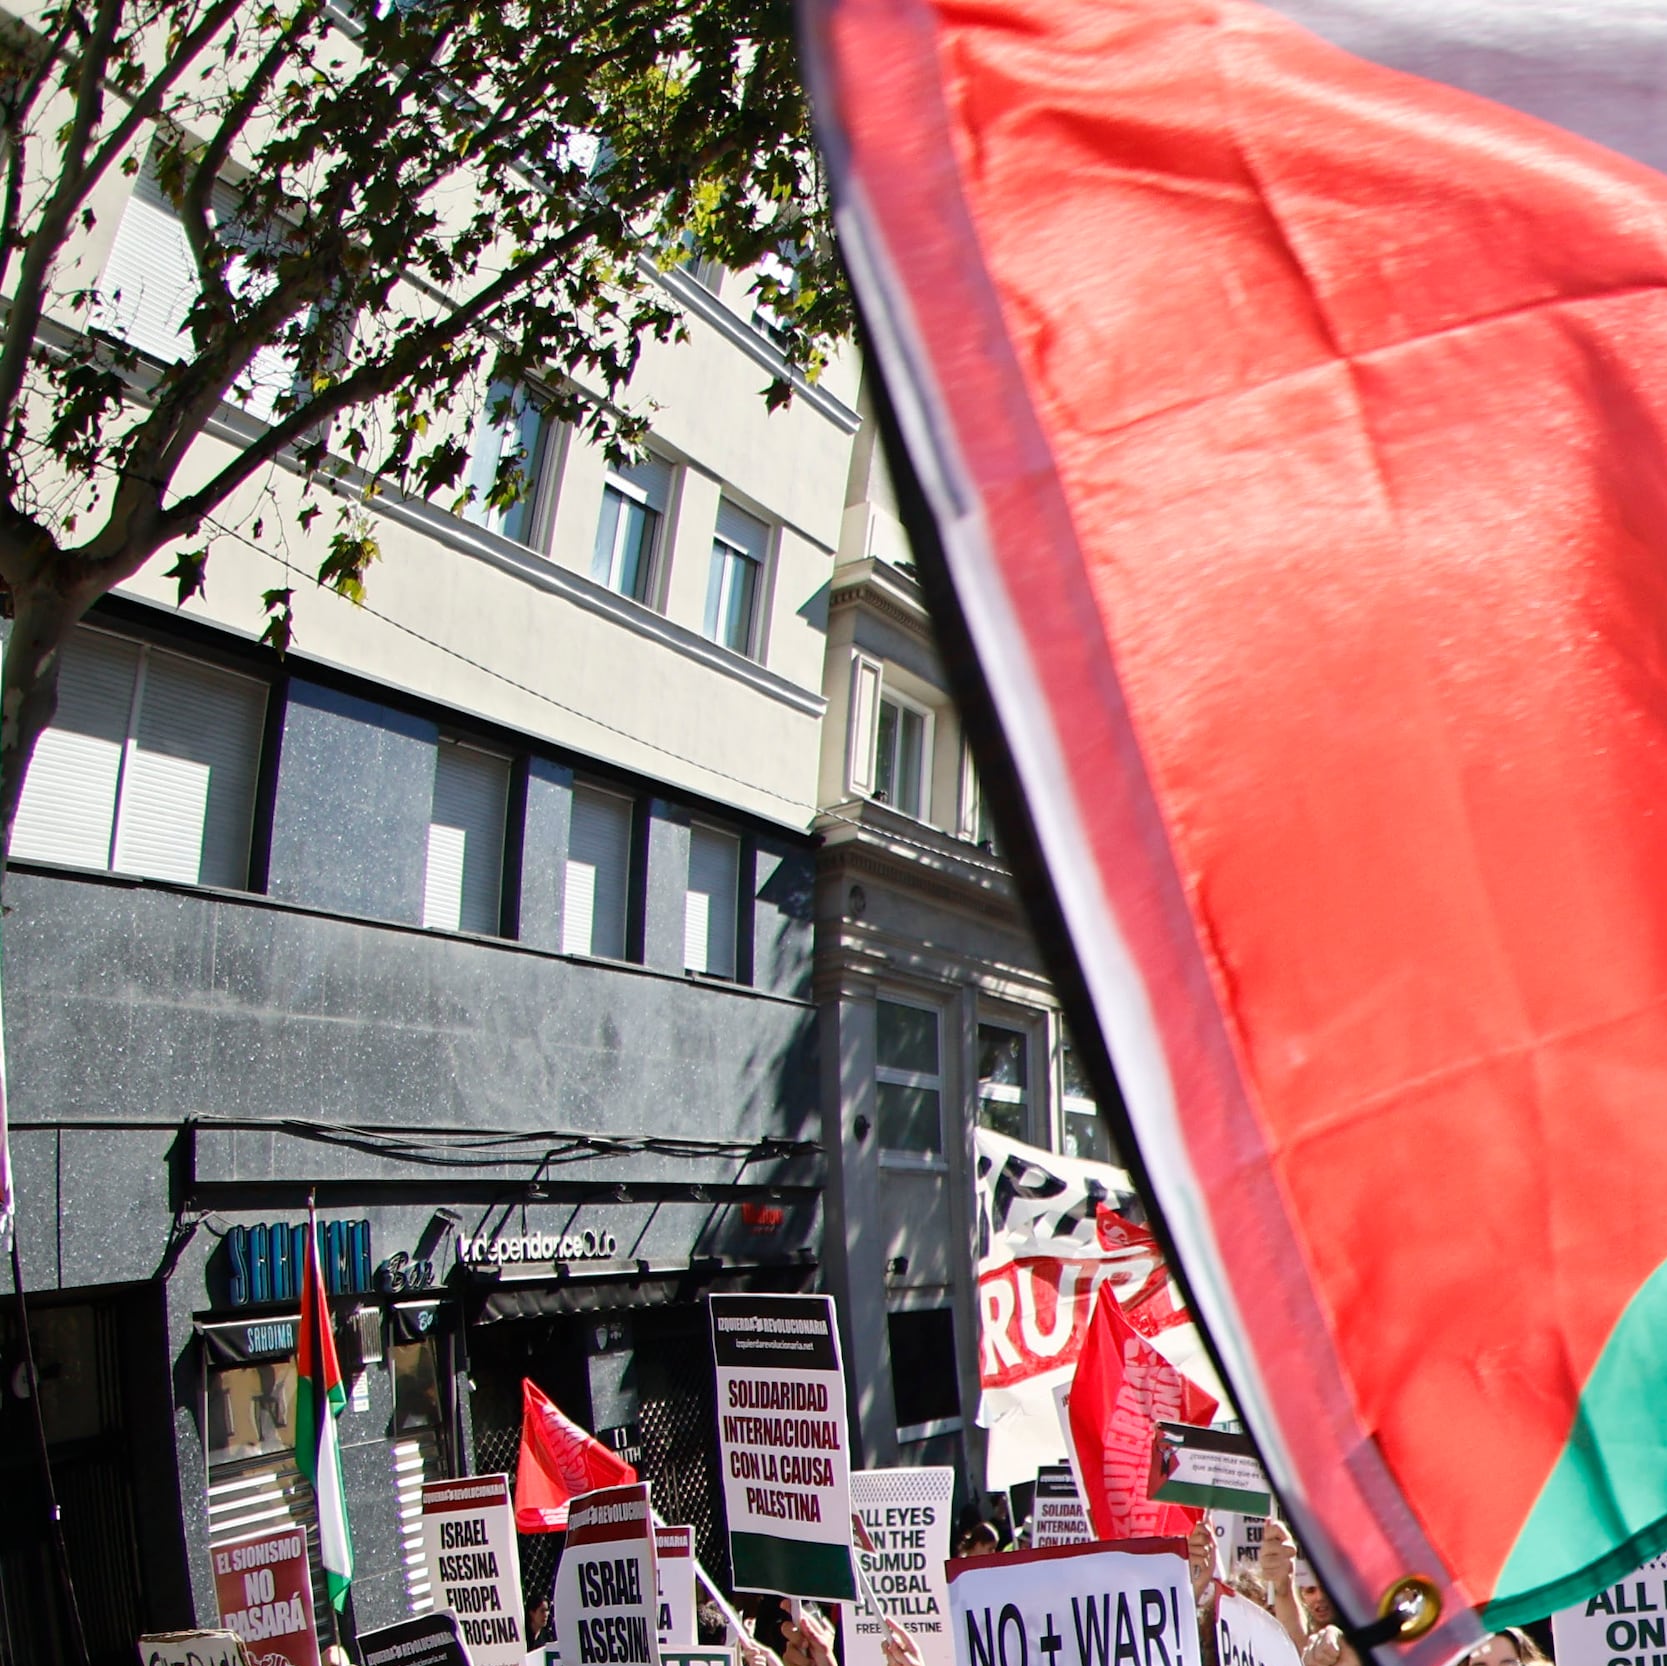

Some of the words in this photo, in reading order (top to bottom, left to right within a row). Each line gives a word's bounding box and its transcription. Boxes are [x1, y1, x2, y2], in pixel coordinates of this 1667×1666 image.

[247, 1323, 294, 1353] SAHOIMA
[763, 1318, 829, 1337] REVOLUCIONARIA
[728, 1379, 829, 1413] SOLIDARIDAD
[723, 1415, 841, 1452] INTERNACIONAL
[730, 1450, 760, 1481] CON
[760, 1454, 779, 1484] LA
[780, 1456, 835, 1487] CAUSA
[746, 1487, 822, 1524] PALESTINA
[886, 1506, 936, 1528] EYES
[439, 1518, 489, 1550] ISRAEL
[890, 1529, 926, 1549] THE
[217, 1553, 236, 1576] EL
[234, 1539, 301, 1571] SIONISMO
[438, 1552, 499, 1583] ASESINA
[860, 1552, 927, 1573] SUMUD
[244, 1569, 276, 1607] NO
[577, 1558, 642, 1609] ISRAEL
[868, 1575, 932, 1595] LOBAL
[1585, 1580, 1661, 1618] ALL
[225, 1596, 307, 1643] PASARÁ
[1605, 1613, 1667, 1653] ON
[578, 1616, 651, 1666] ASESINA
